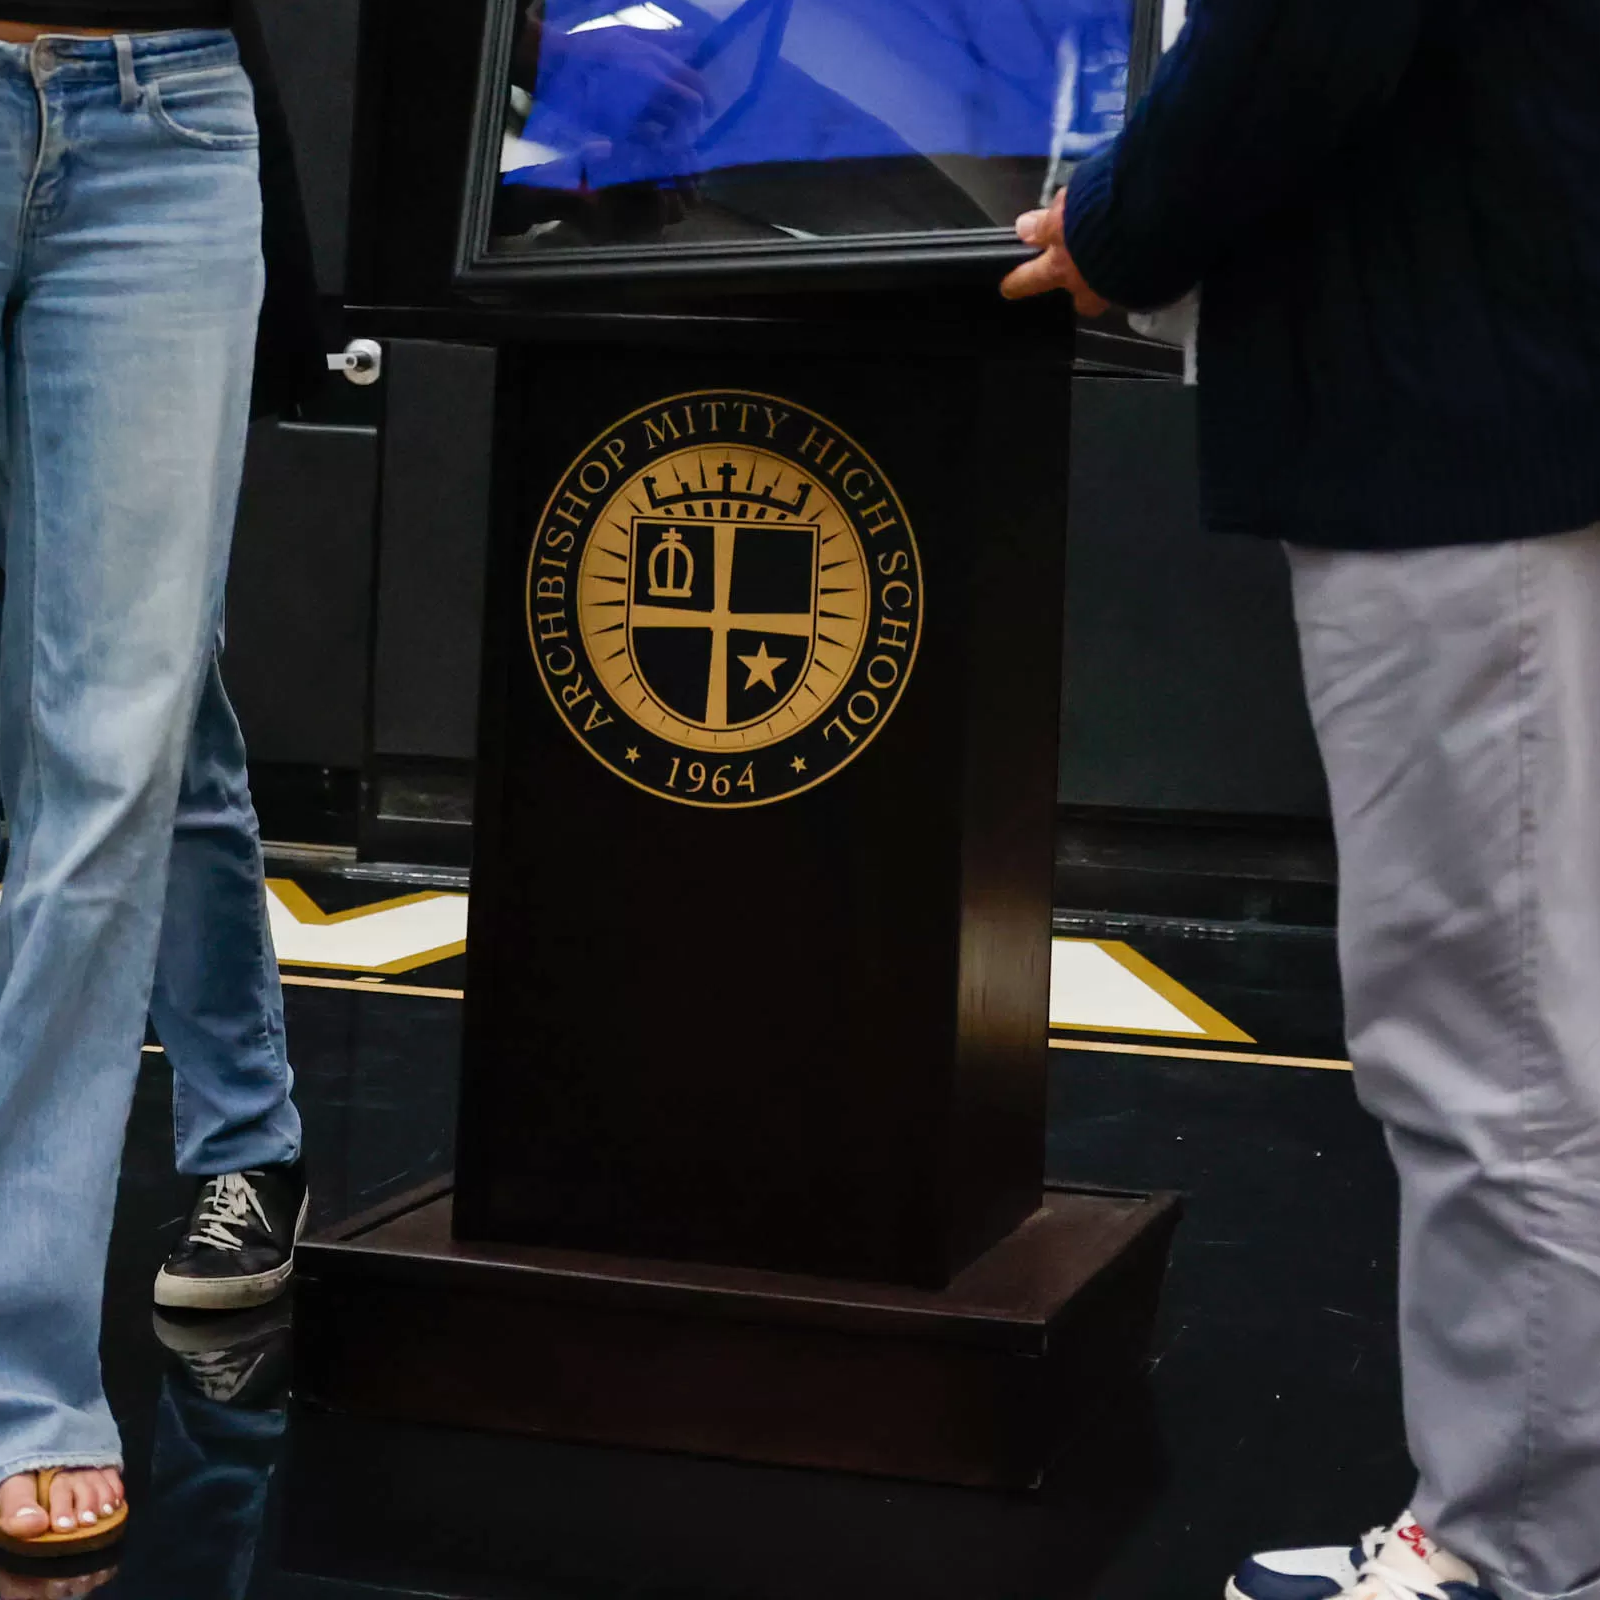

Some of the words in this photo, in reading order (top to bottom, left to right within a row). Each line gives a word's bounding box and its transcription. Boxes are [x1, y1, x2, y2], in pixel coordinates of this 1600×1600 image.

[642, 401, 789, 450] MITTY
[798, 426, 896, 537] HIGH
[538, 438, 627, 734] ARCHBISHOP
[822, 551, 913, 748] SCHOOL
[664, 757, 756, 797] 1964
